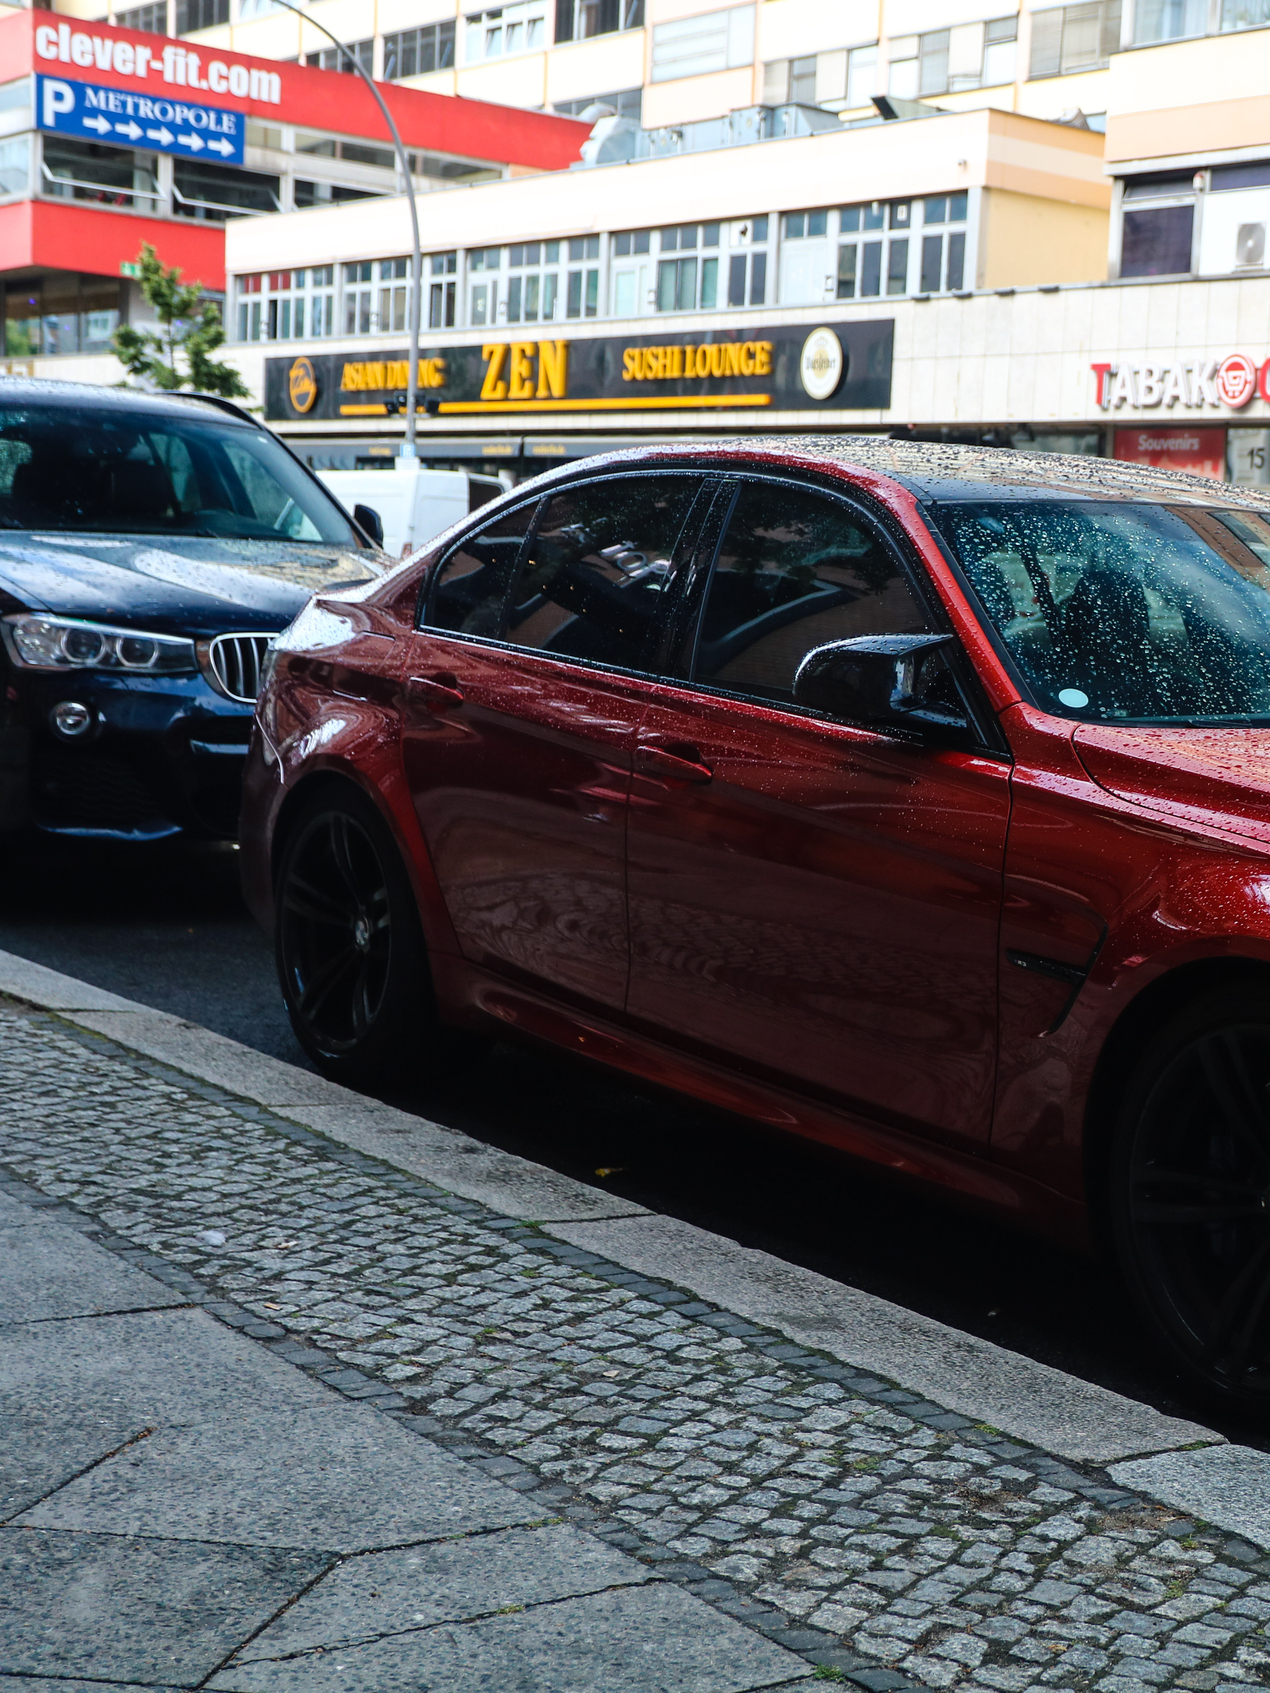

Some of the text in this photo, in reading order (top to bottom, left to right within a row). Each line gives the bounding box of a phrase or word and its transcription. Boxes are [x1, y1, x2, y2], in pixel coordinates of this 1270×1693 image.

[35, 22, 282, 105] clever-fit.com
[43, 77, 237, 135] P METROPOLE
[340, 361, 387, 392] ASIAN
[480, 340, 569, 400] ZEN
[622, 341, 773, 381] SUSHI LOUNGE
[1090, 359, 1219, 409] TABAK
[1138, 434, 1200, 451] Souvenirs
[1247, 448, 1265, 470] 15
